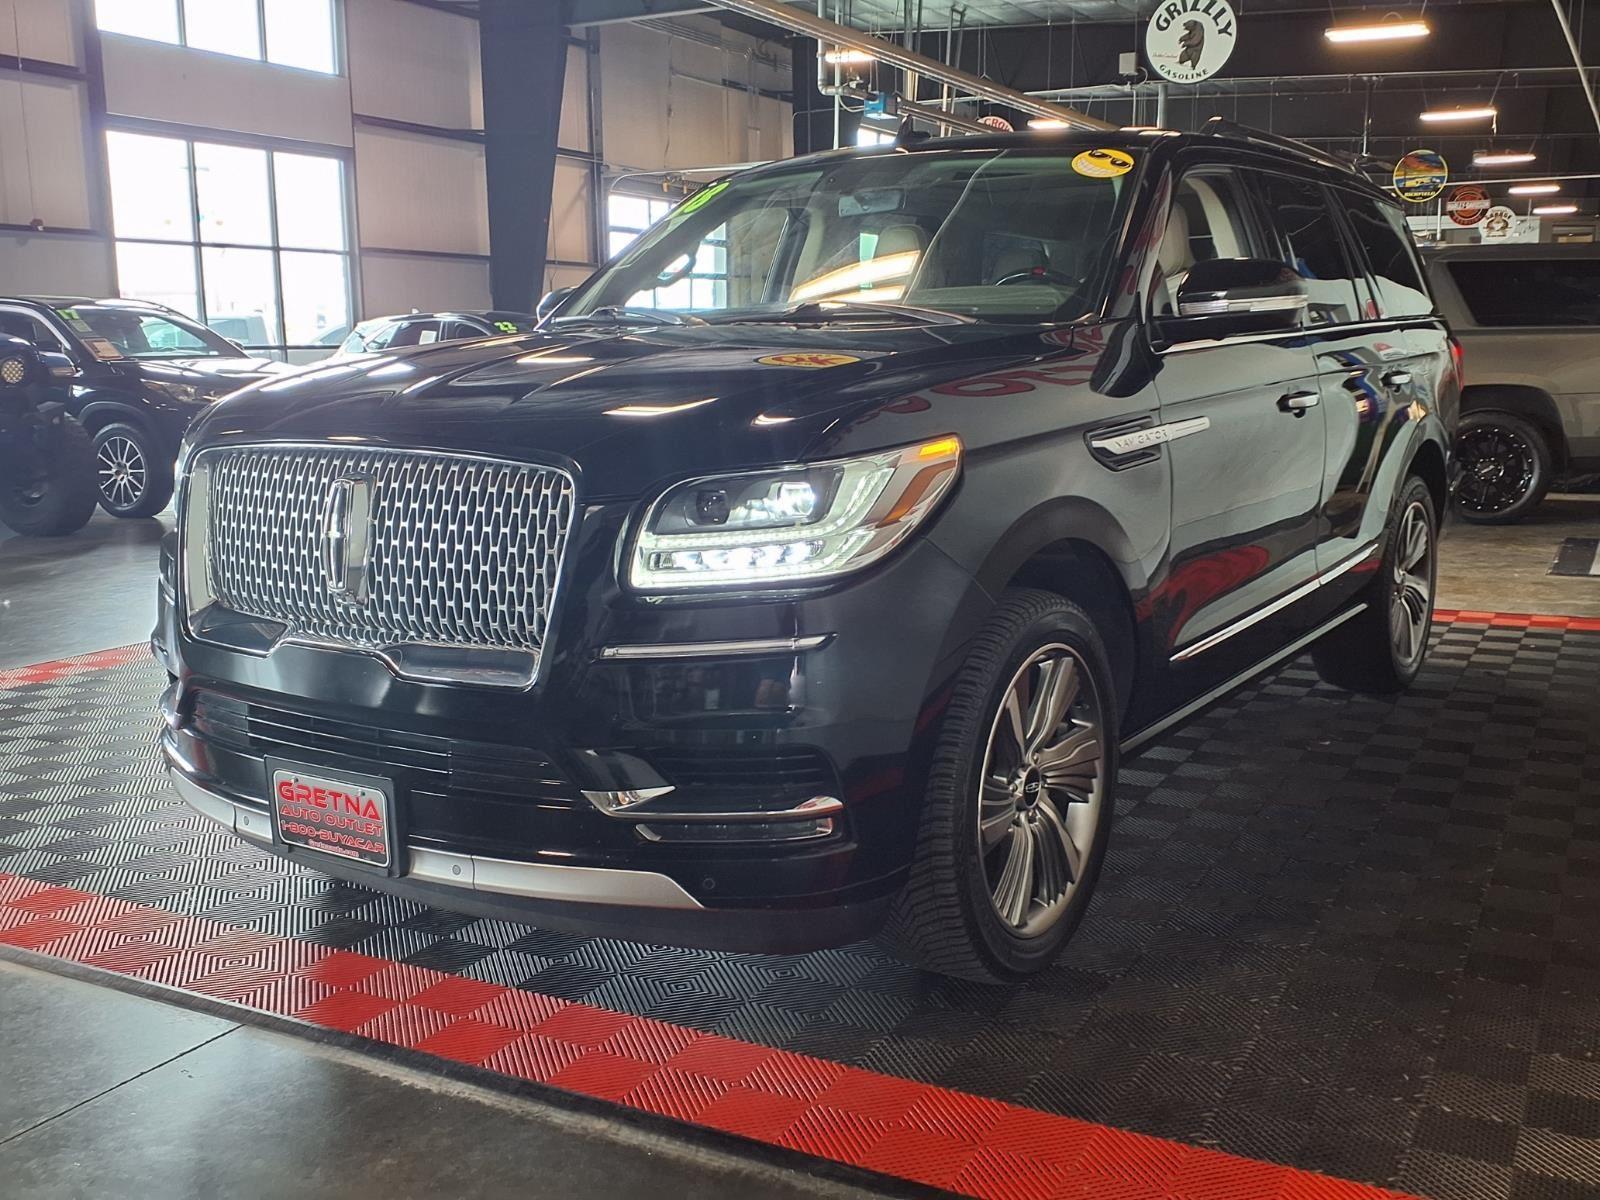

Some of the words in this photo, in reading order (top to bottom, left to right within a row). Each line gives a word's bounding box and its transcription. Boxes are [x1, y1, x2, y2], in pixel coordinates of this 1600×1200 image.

[1155, 0, 1232, 37] GRIZZLY
[1159, 64, 1209, 80] GASOLINE
[278, 781, 382, 821] GRETNA
[280, 804, 321, 823] AUTO
[324, 813, 384, 837] OUTLET
[280, 819, 386, 854] 1-800-BUYACAR
